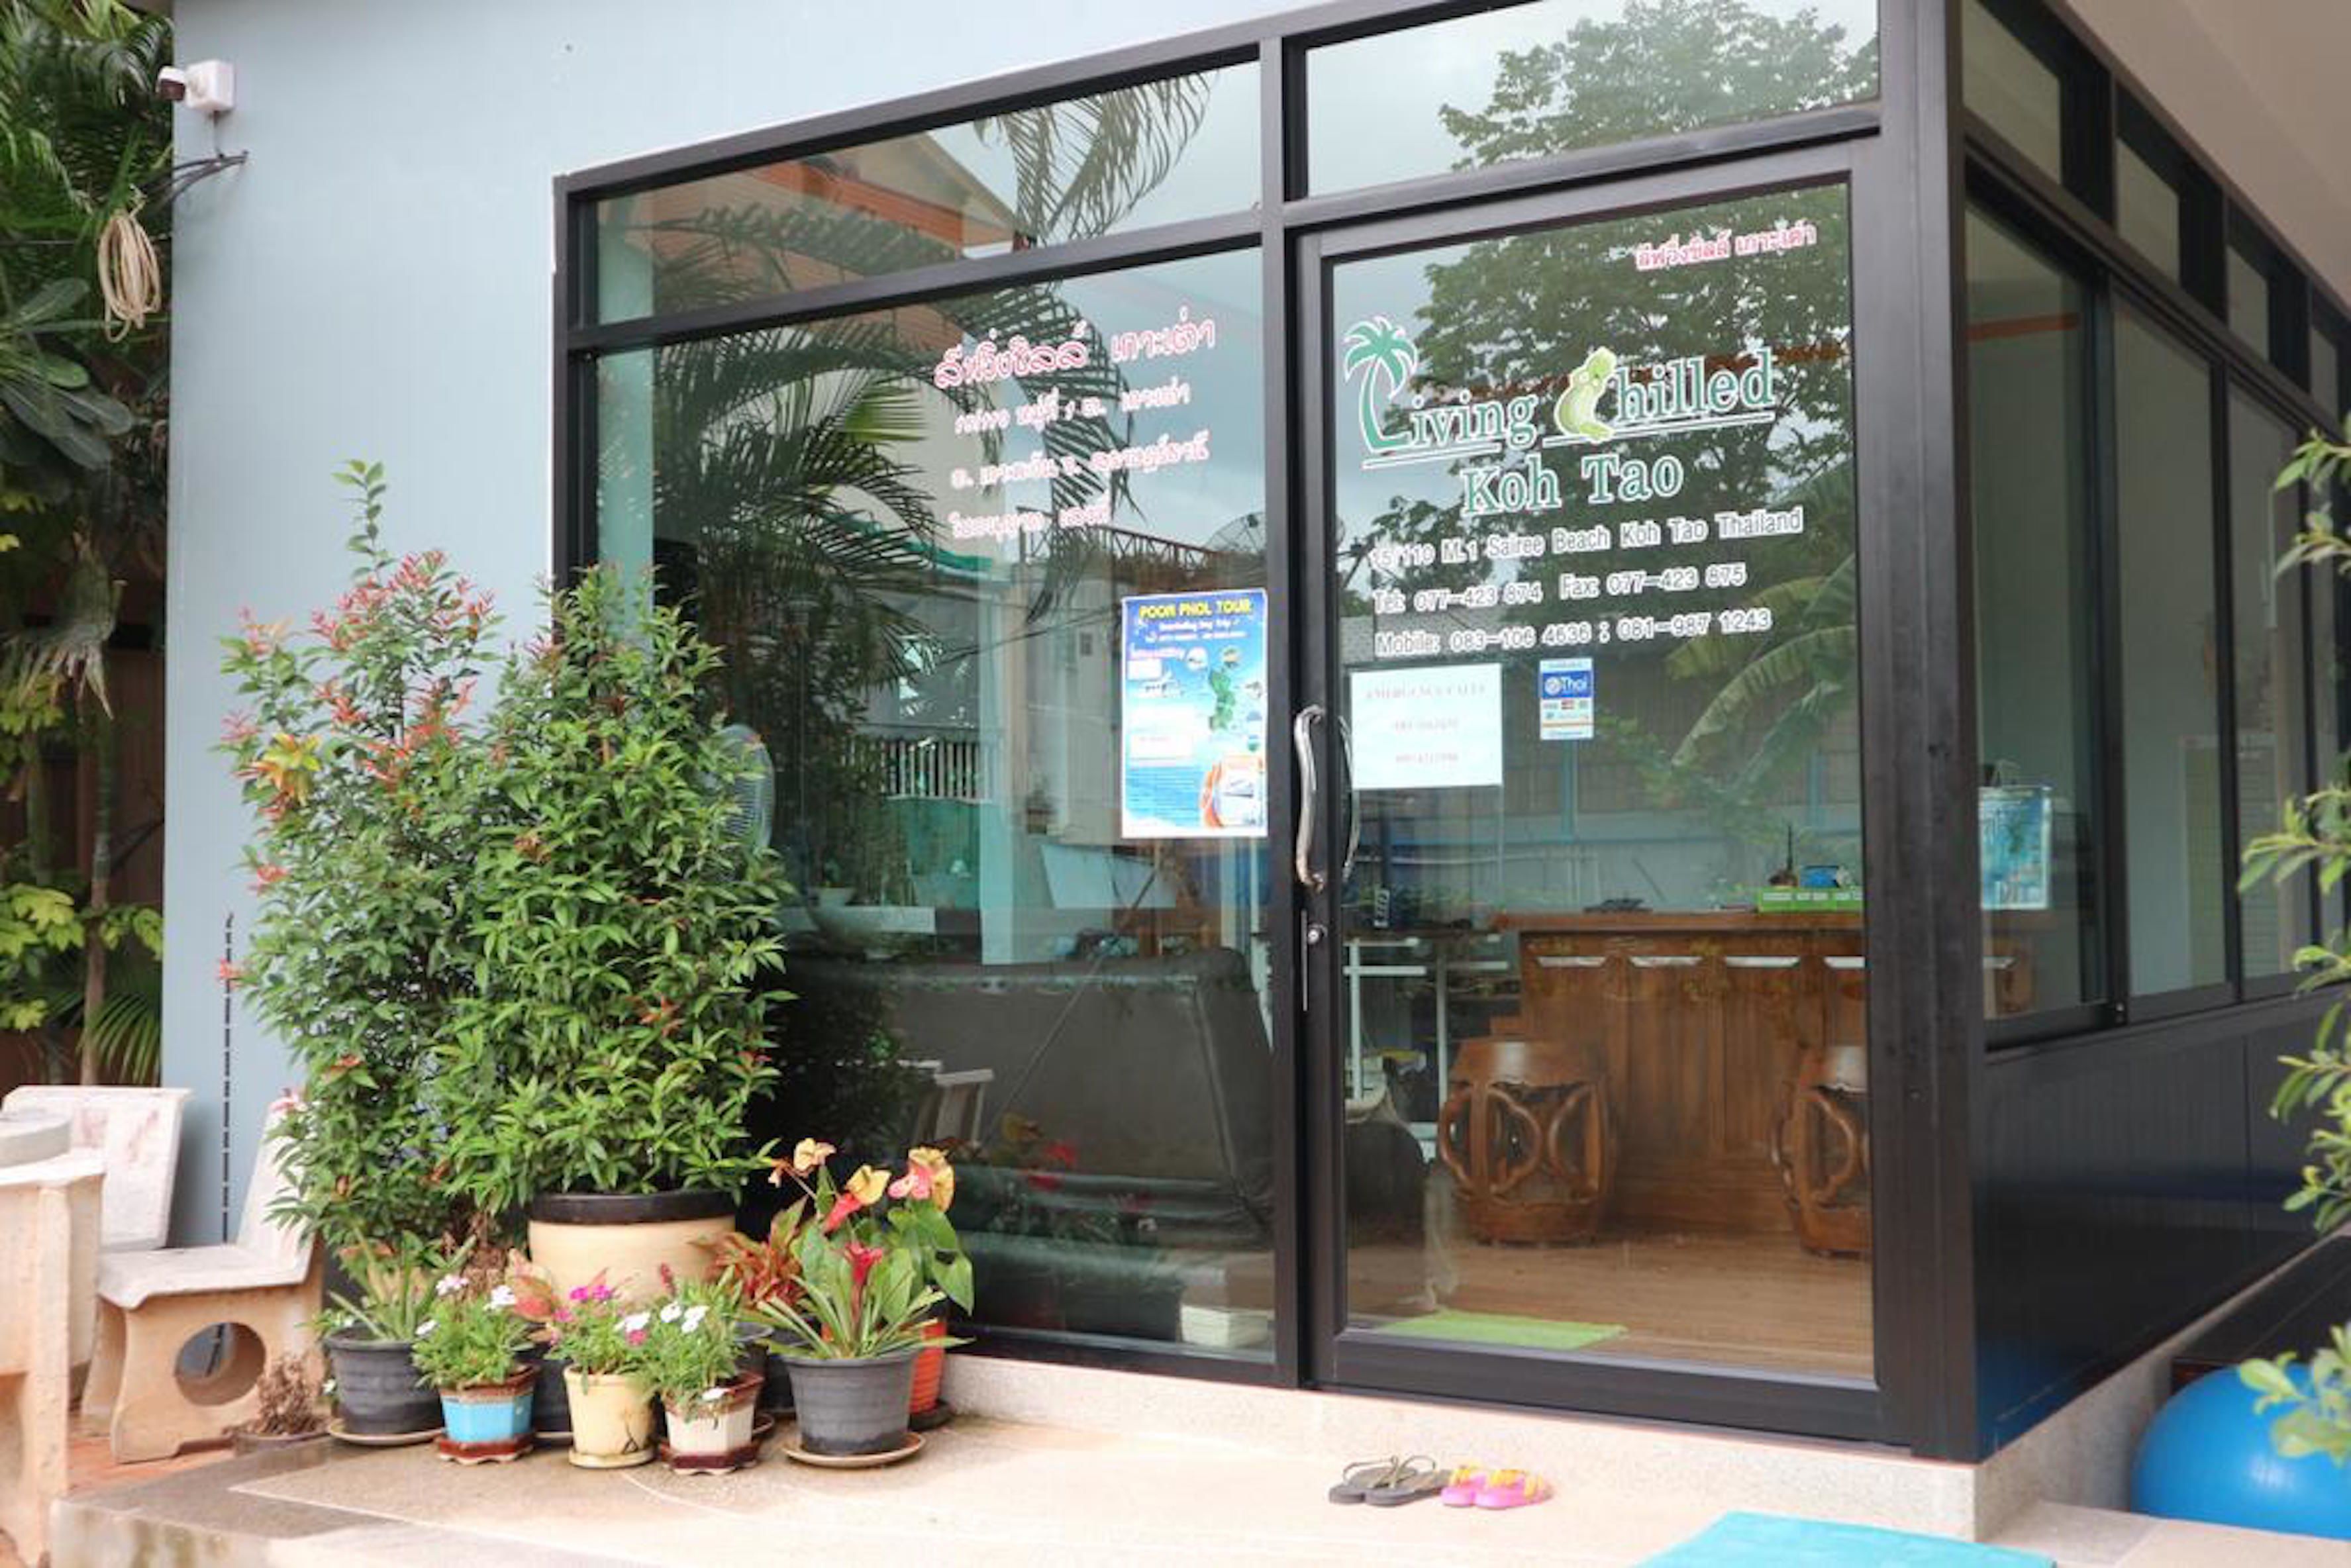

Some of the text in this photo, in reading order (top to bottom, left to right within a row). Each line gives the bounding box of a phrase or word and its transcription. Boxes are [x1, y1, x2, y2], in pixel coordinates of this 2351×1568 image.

[1111, 306, 1217, 363] เกาะเต่า
[1344, 318, 1538, 453] Living
[1462, 452, 1685, 516] Koh Tao
[1485, 532, 1546, 559] Sairee
[1551, 524, 1611, 554] Beach
[1620, 520, 1661, 549] Koh
[1667, 516, 1709, 545] Tao
[1714, 505, 1804, 540] Thailand
[1704, 562, 1748, 587] 875
[1719, 607, 1773, 634] 1243
